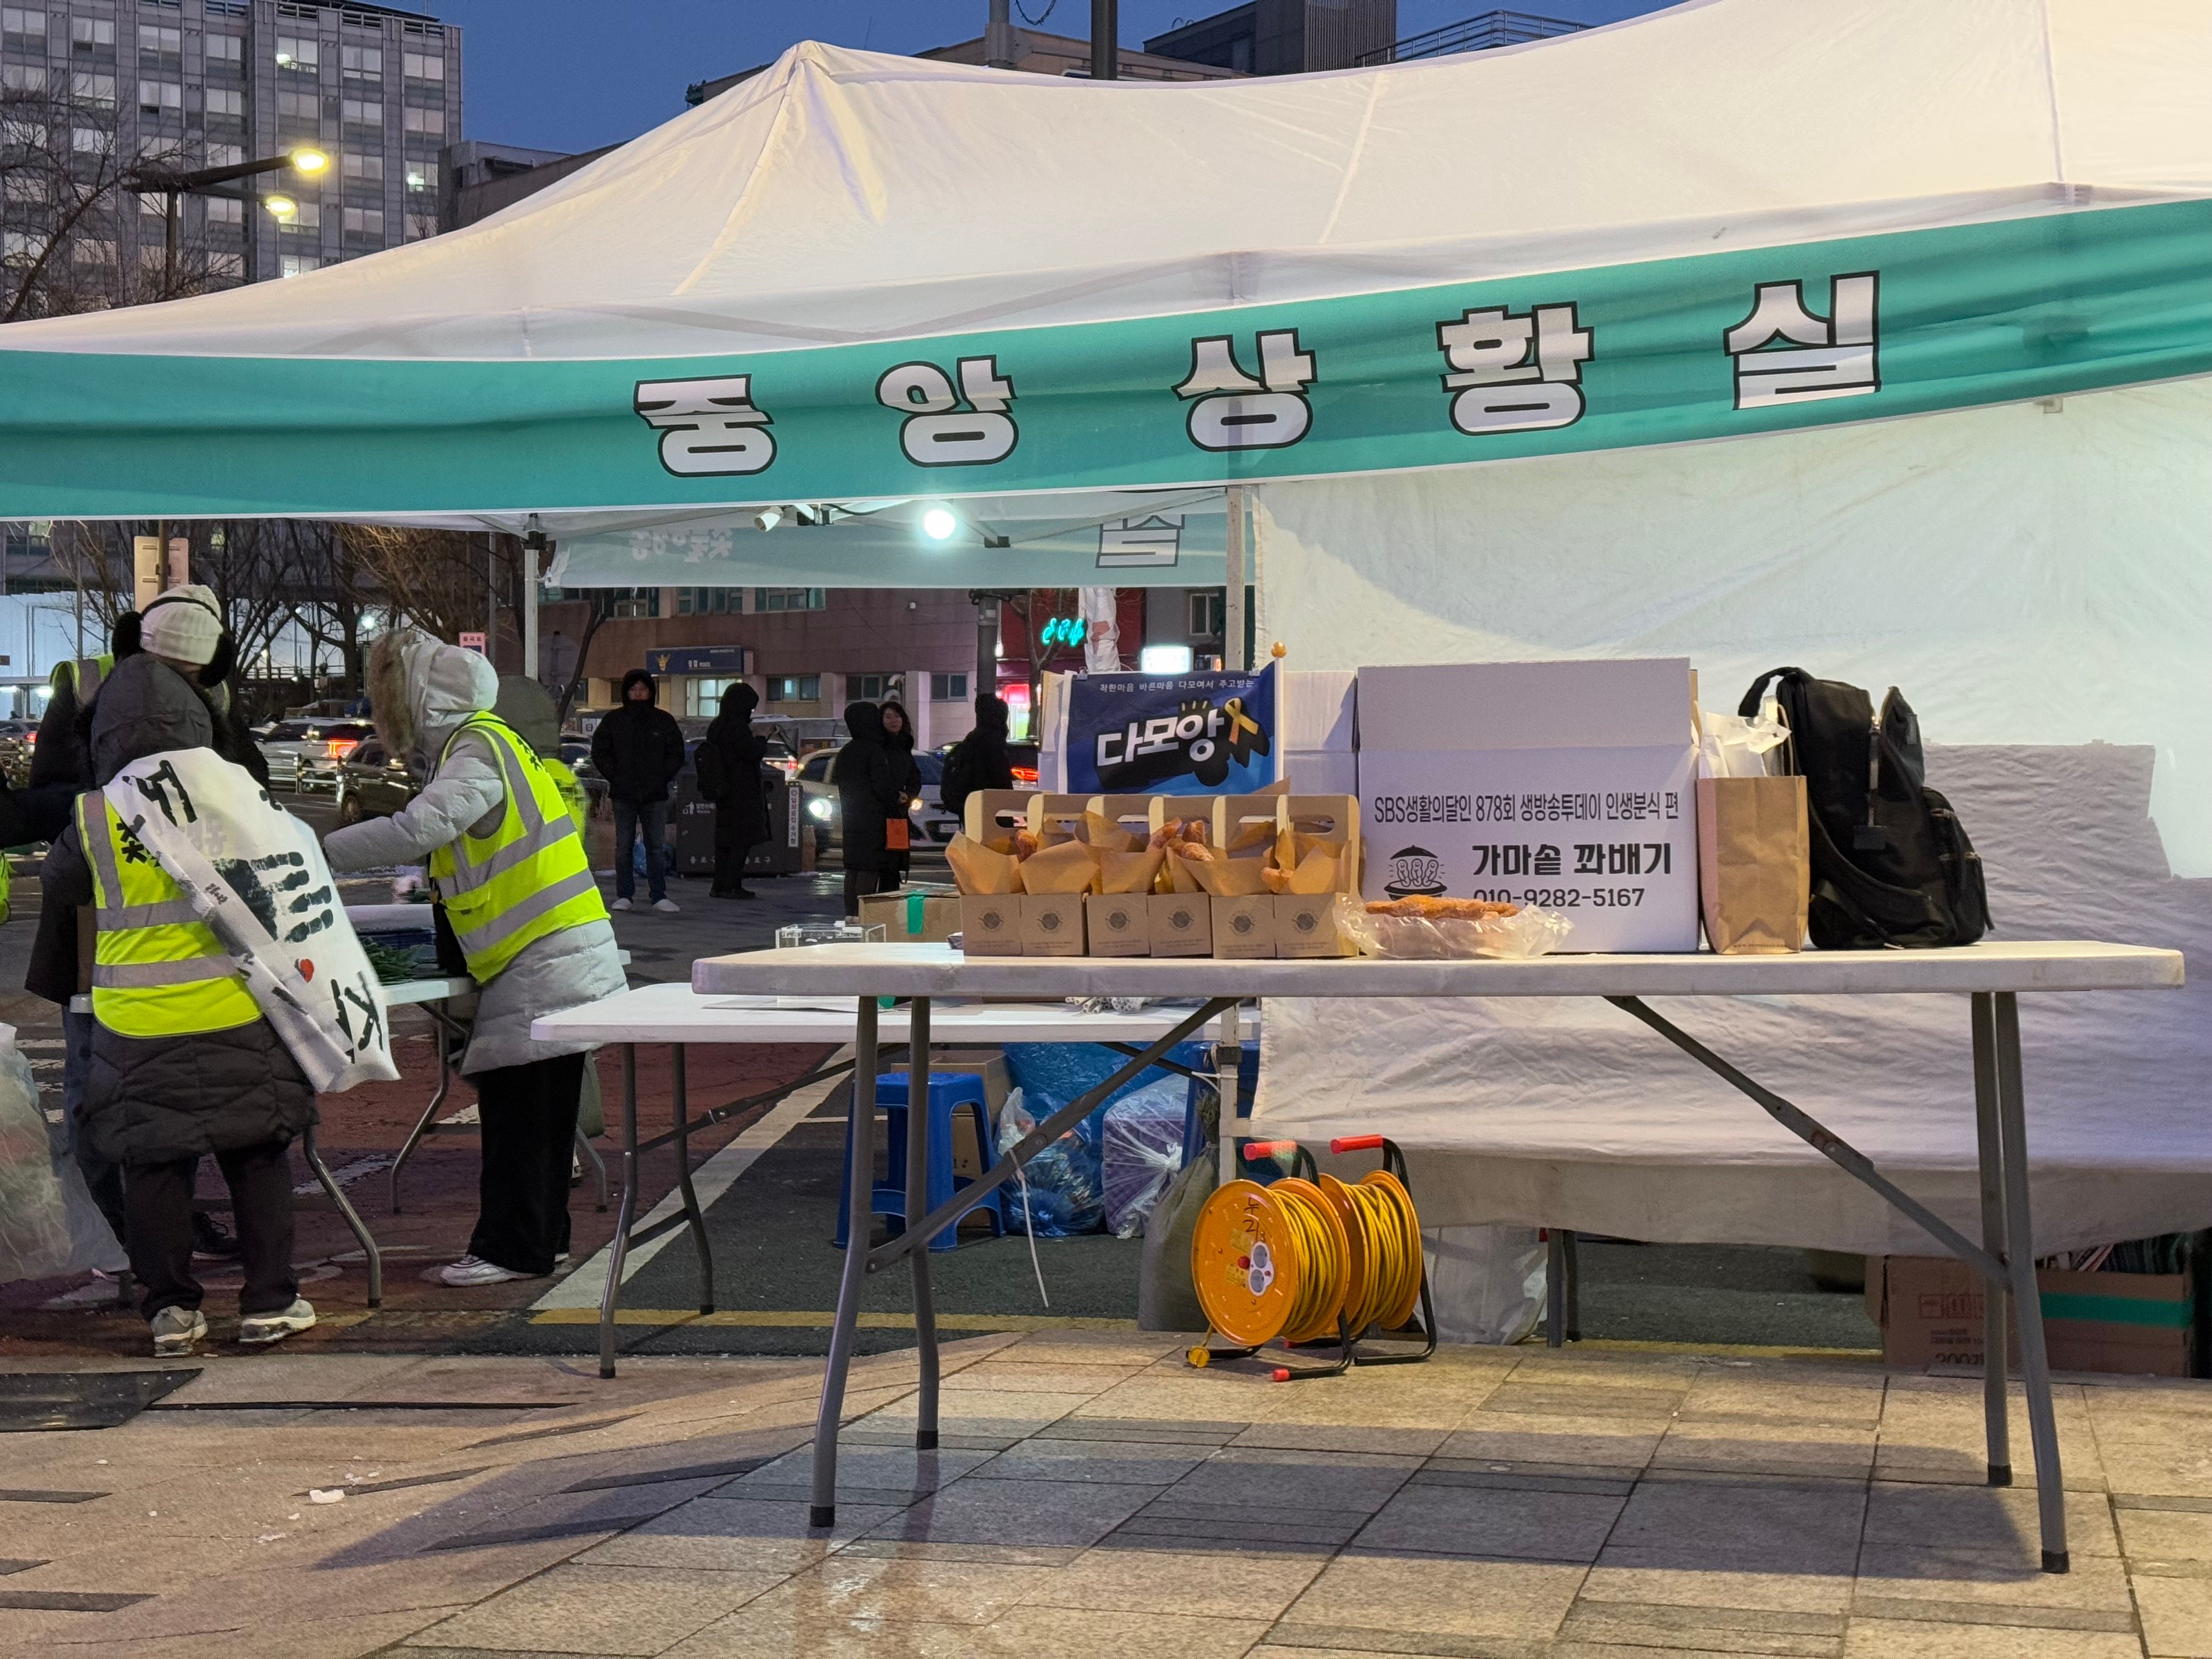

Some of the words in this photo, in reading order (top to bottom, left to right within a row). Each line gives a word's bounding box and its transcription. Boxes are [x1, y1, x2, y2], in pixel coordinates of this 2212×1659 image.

[1178, 680, 1214, 690] 다모여서
[1218, 679, 1255, 689] 주고받는
[1097, 708, 1224, 767] 다모앙
[1374, 794, 1471, 823] SBS생활의달인
[1476, 794, 1516, 822] 878회
[1520, 793, 1601, 821] 생방송투데이
[1606, 792, 1661, 820] 인생분식
[1665, 792, 1679, 820] 편
[1472, 844, 1562, 876] 가마솥
[1573, 843, 1671, 875] 꽈배기
[1473, 888, 1645, 907] 010-9282-5167
